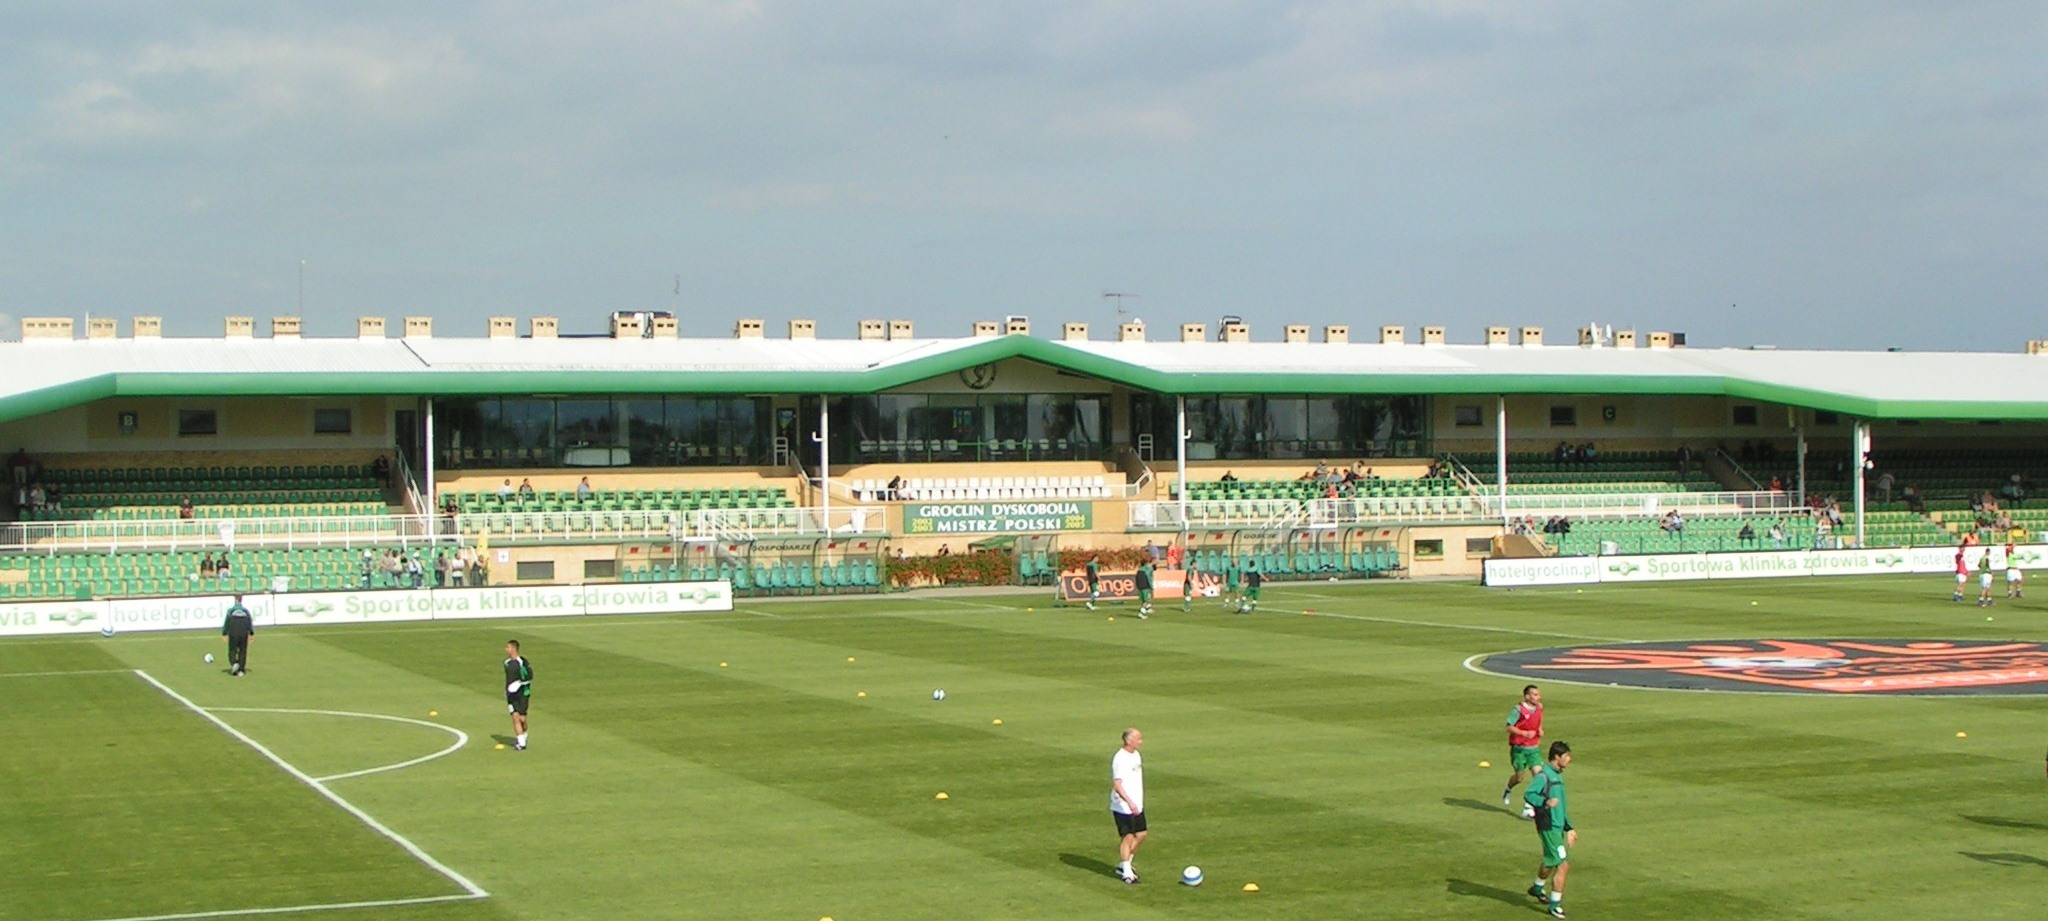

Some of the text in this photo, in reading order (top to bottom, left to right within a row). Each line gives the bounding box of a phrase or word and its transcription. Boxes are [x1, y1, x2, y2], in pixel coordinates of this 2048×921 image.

[123, 415, 133, 426] B
[920, 503, 1079, 517] GROCLIN DYSKOBOLIA
[937, 517, 1061, 532] MISTRZ POLSKI
[1648, 551, 1868, 576] Sportowa klinika zdrowia
[1913, 550, 2004, 568] hotelgclpl
[1488, 561, 1596, 583] hotelgroclin.pl
[1071, 576, 1134, 596] Onge
[345, 587, 669, 618] Sportowa klinika zdrowia
[114, 600, 269, 626] hotelgroclpl
